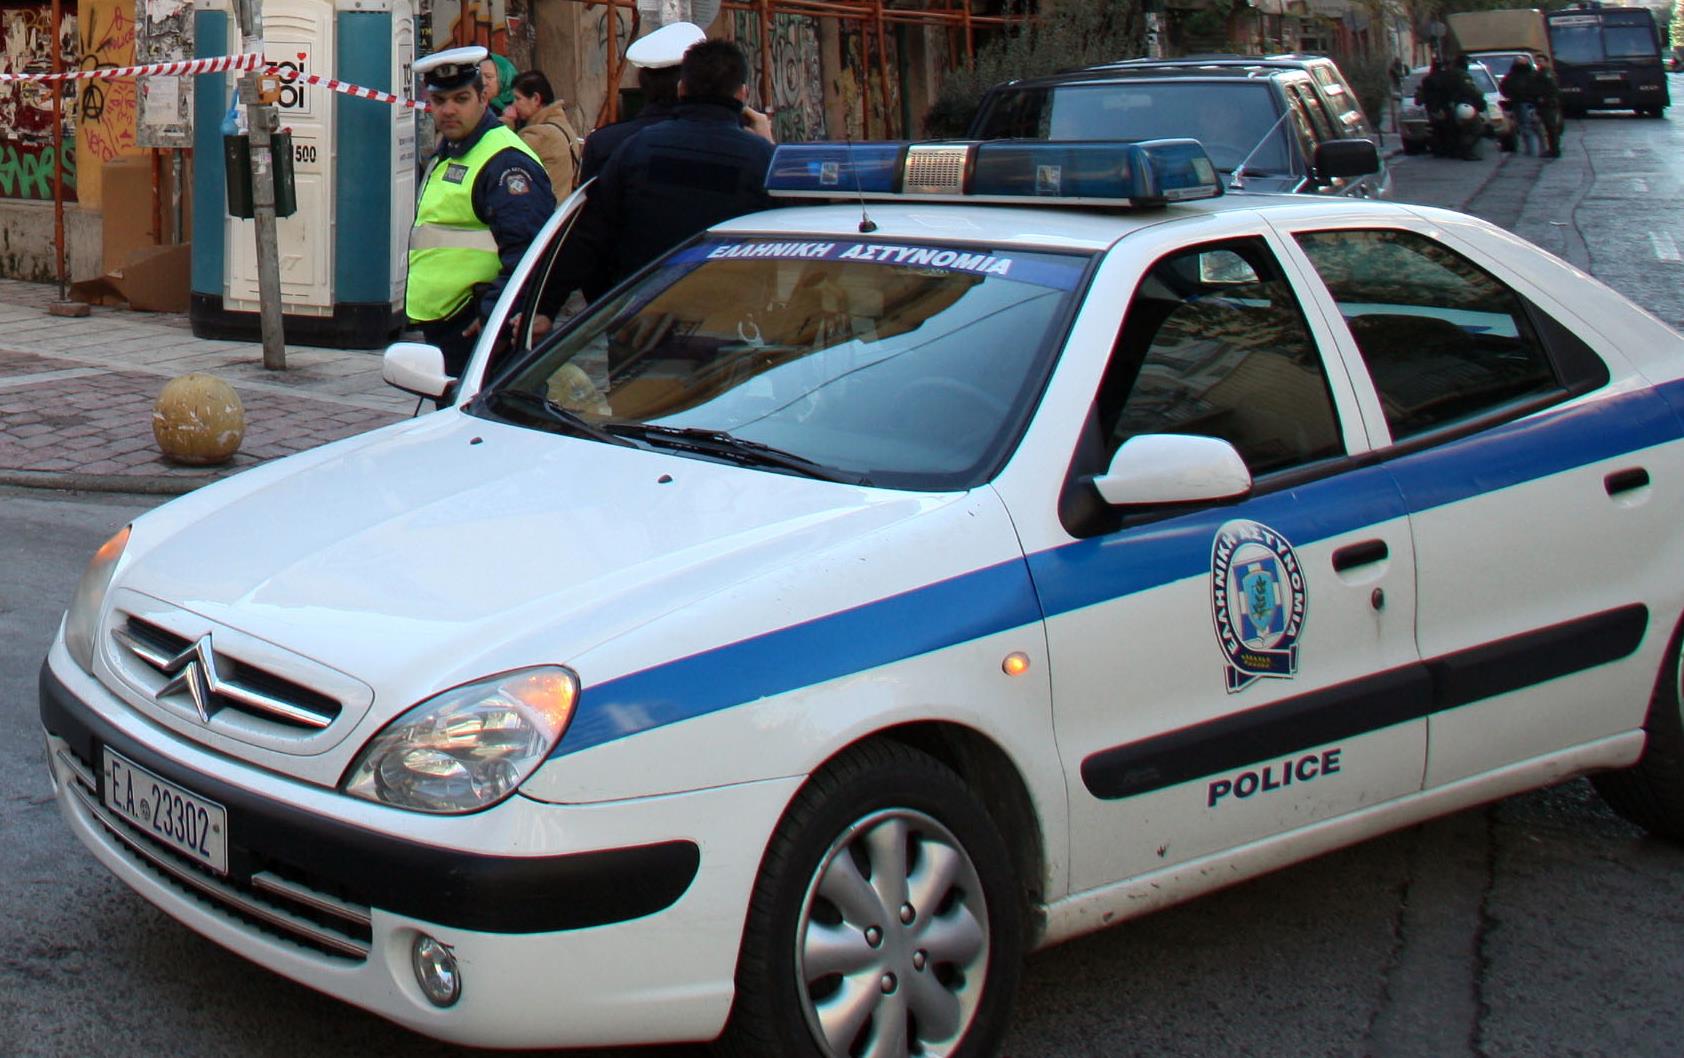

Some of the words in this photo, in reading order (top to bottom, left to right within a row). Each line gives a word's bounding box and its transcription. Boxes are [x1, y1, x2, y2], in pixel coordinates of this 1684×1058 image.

[707, 242, 836, 259] ΕΛΛΗΝΙΚΗ
[839, 243, 1014, 276] ΑΣΤΥΝΟΜΙΑ
[1208, 748, 1342, 808] POLICE
[152, 783, 210, 858] 23302
